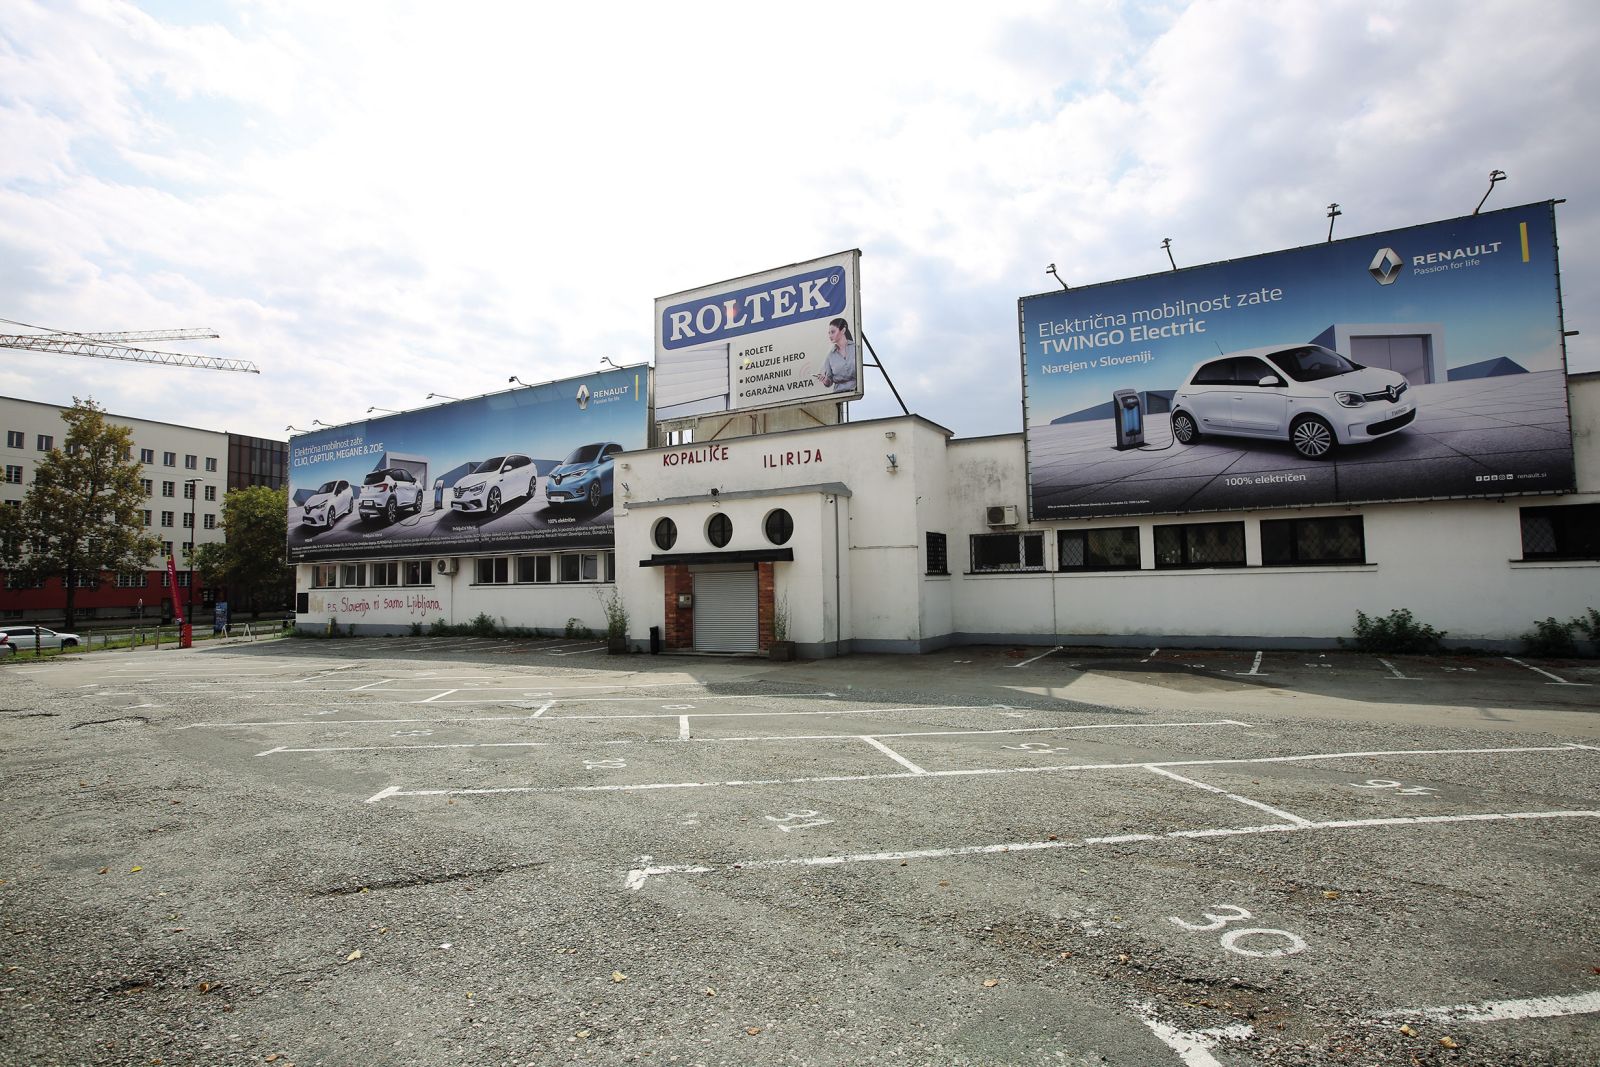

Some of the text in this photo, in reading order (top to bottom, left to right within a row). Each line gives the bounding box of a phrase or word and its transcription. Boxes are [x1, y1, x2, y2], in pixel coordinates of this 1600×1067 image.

[1412, 241, 1502, 266] RENAULT
[1413, 258, 1481, 276] Passion for life
[1039, 287, 1283, 338] Električna mobilnost zate
[1040, 319, 1207, 355] TWINGO Electric
[744, 344, 774, 357] ROLETE
[782, 351, 806, 363] HERO
[1041, 350, 1155, 375] Narejen v Sloveniji.
[745, 368, 792, 384] KOMARNIKI
[593, 386, 629, 399] RENAULT
[745, 379, 814, 398] GARAŽNA VRATA
[321, 440, 350, 452] mobilnost
[350, 437, 363, 446] zate
[309, 451, 336, 464] CAPTUR,
[336, 447, 363, 460] MEGANE
[363, 445, 369, 455] &
[763, 448, 823, 469] ILIRIJA
[1224, 473, 1307, 487] 100% električen
[373, 594, 380, 610] ni
[383, 598, 404, 610] samo
[1168, 903, 1307, 958] 30
